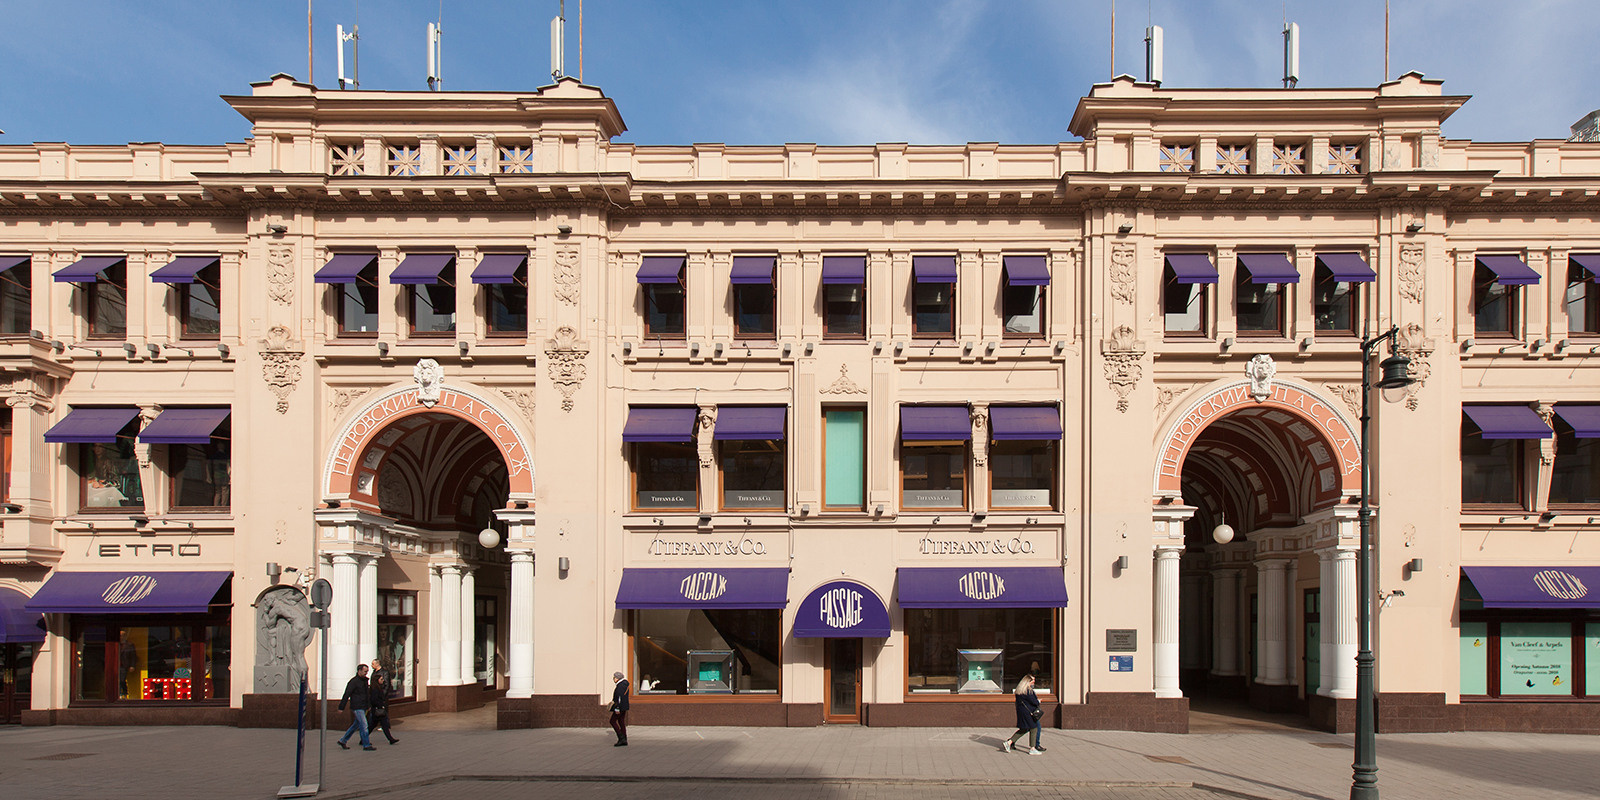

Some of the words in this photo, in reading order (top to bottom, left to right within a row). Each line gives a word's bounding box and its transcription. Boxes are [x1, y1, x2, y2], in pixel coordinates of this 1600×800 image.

[333, 391, 418, 475] ПЕТРОВСКИЙ
[443, 392, 530, 475] ПАССАЖ
[1160, 386, 1248, 477] ПЕТРОВСКИЙ
[1273, 387, 1361, 475] ПАССАЖ
[99, 544, 201, 557] ETRO
[652, 539, 723, 556] TIFFANY
[724, 540, 739, 555] &
[920, 538, 991, 555] TIFFANY
[992, 539, 1006, 555] &
[101, 575, 158, 604] ПАССАЖ
[680, 572, 728, 600] ПАССАЖ
[959, 571, 1006, 600] ПАССАЖ
[1533, 570, 1588, 600] ПАССАЖ
[820, 588, 864, 628] PASSAGE
